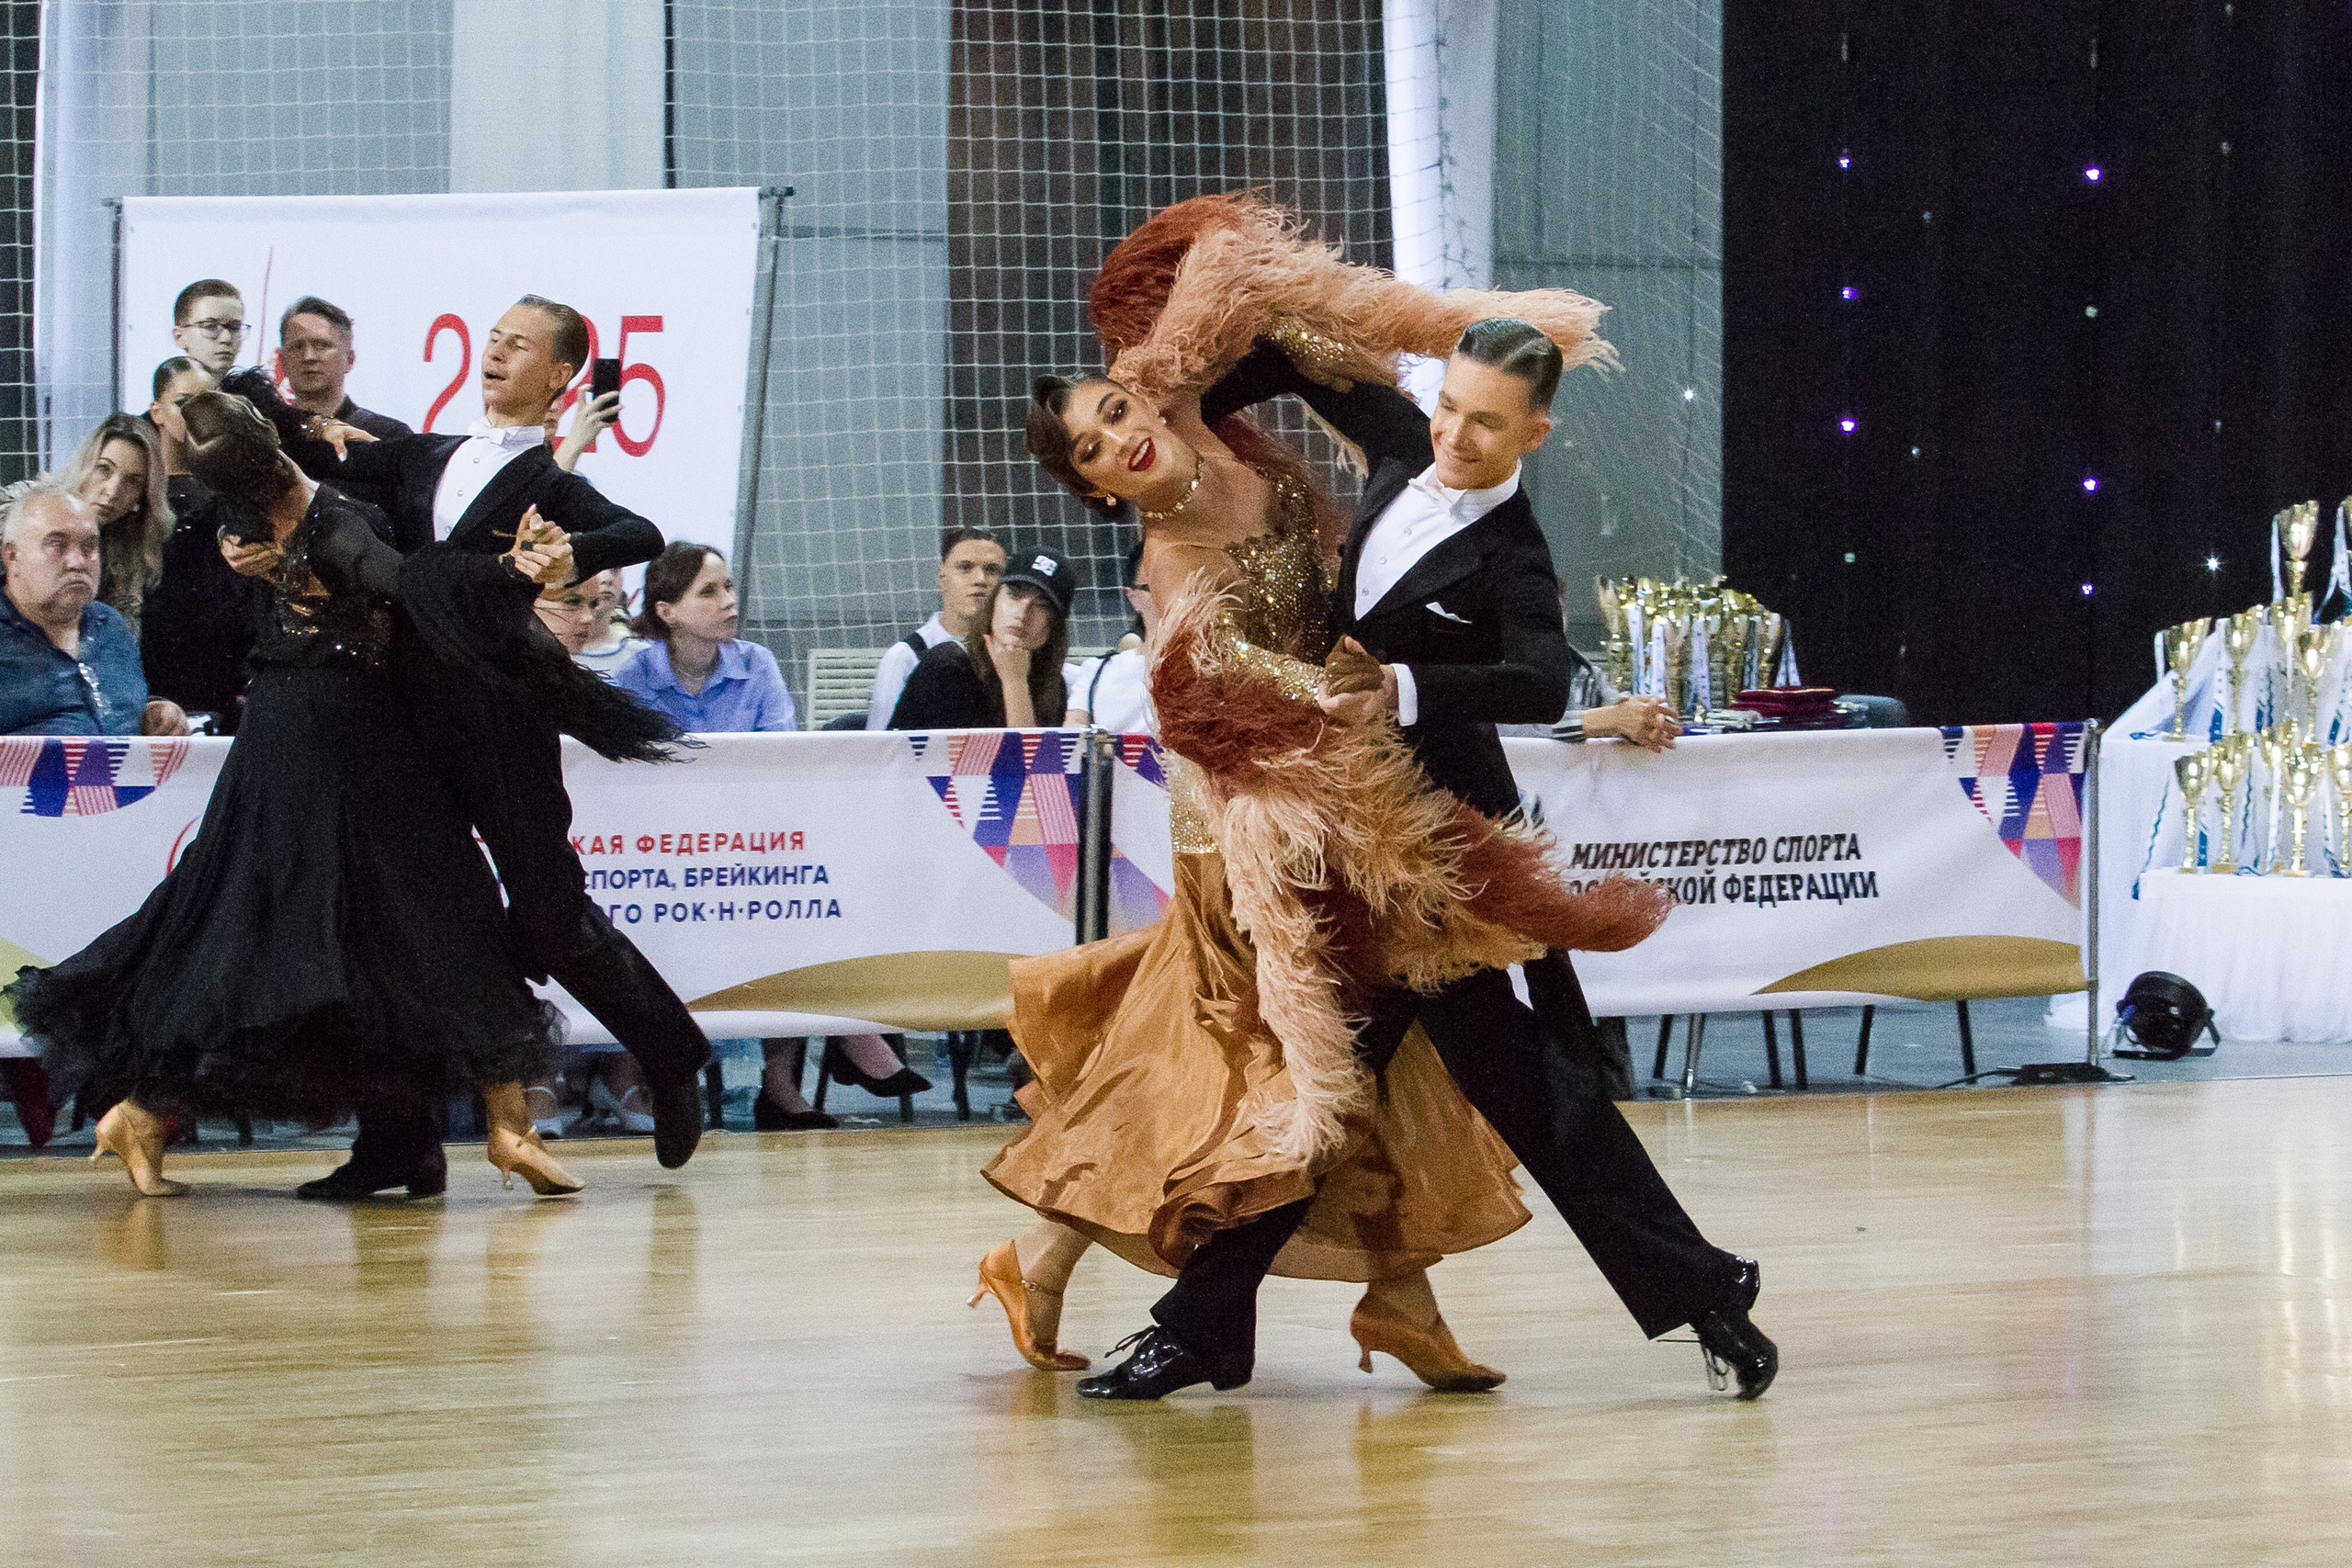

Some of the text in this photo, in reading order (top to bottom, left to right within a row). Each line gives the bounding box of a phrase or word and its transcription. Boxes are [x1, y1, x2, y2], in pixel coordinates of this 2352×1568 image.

[423, 313, 665, 457] 225
[636, 830, 804, 856] ФЕДЕРАЦИЯ
[1570, 833, 1861, 869] МИНИСТЕРСТВО СПОРТА
[684, 863, 829, 887] БРЕЙКИНГА
[1724, 871, 1879, 908] ФЕДЕРАЦИИ
